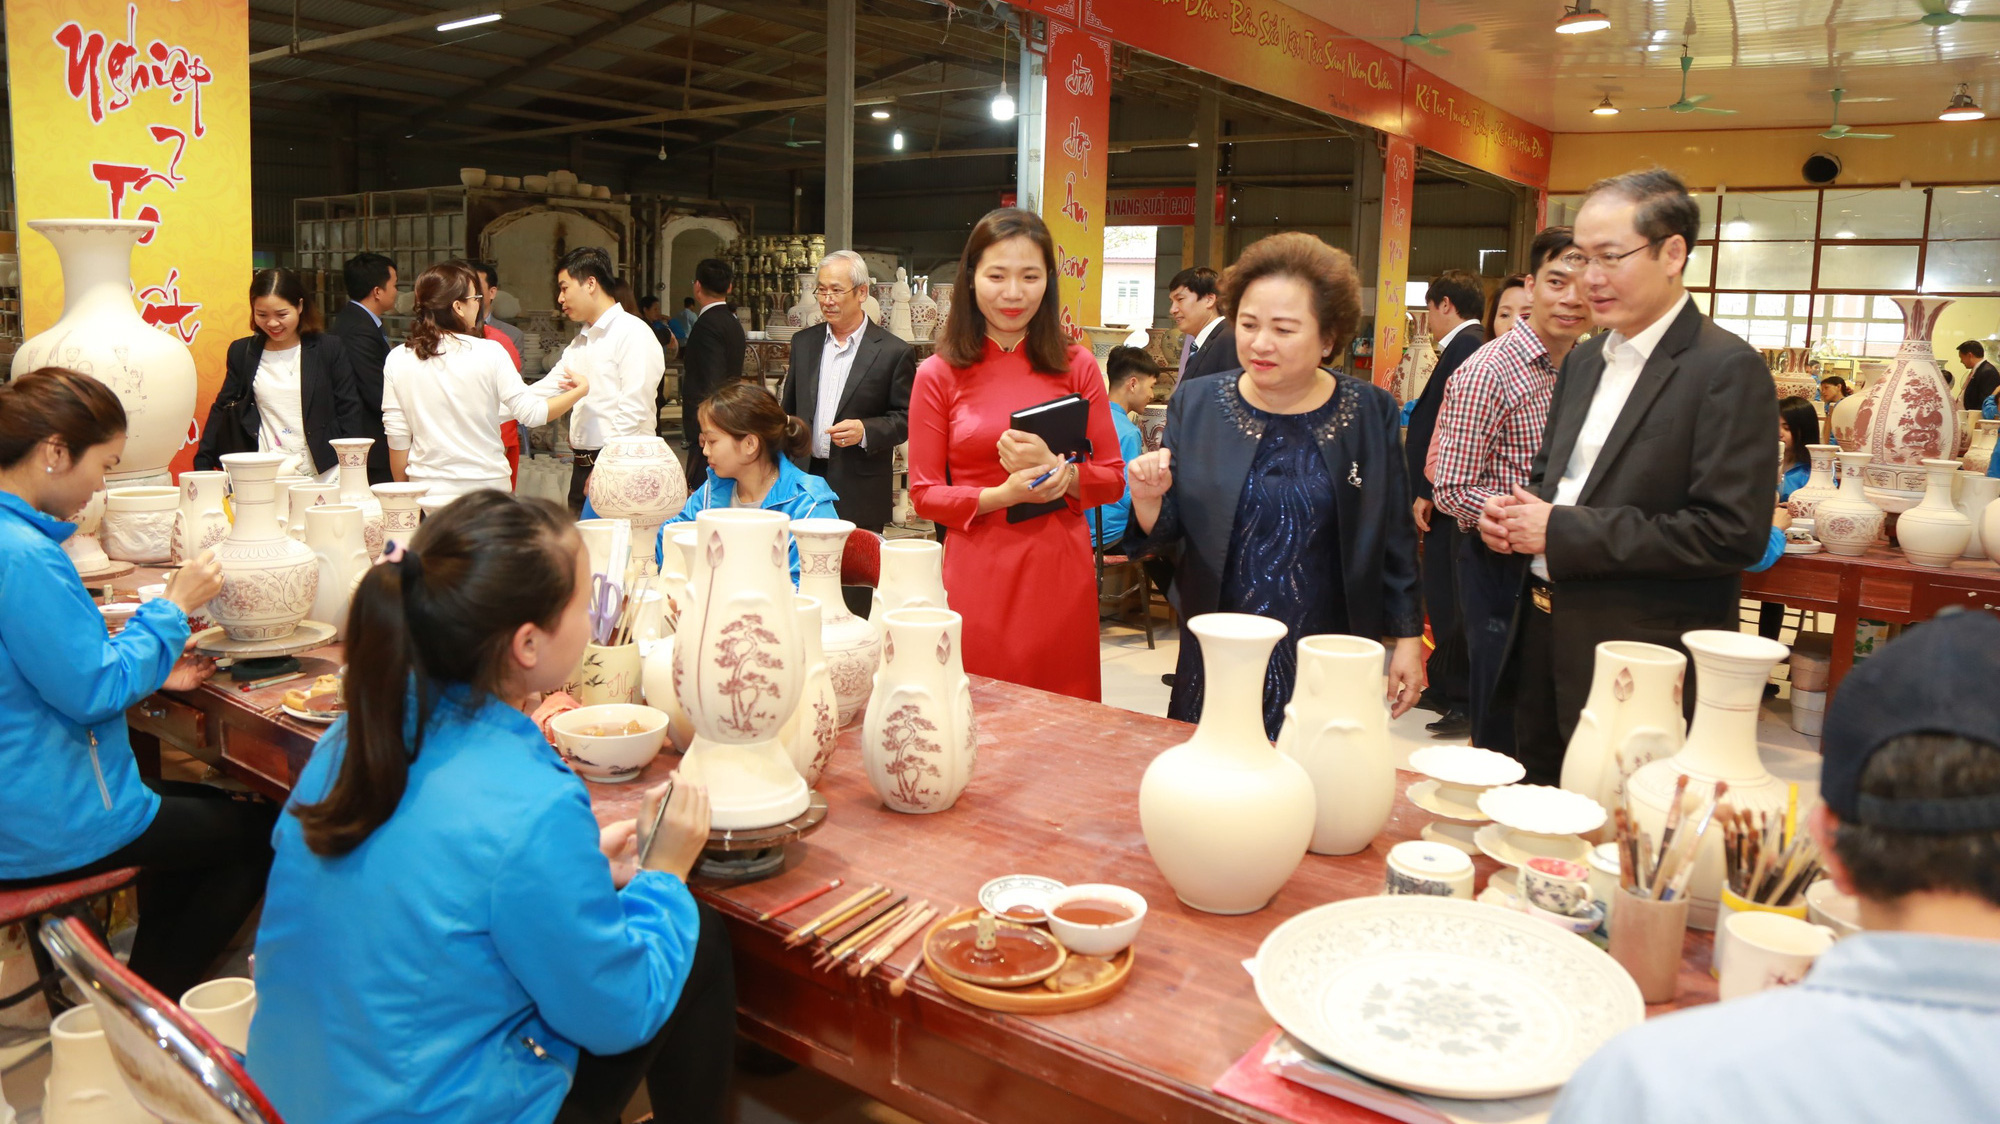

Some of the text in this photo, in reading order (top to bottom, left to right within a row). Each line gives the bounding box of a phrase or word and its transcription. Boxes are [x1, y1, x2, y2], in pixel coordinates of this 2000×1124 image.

[54, 4, 211, 137] Nghiệp
[1142, 191, 1168, 216] SUẤT
[1170, 196, 1190, 216] CAO
